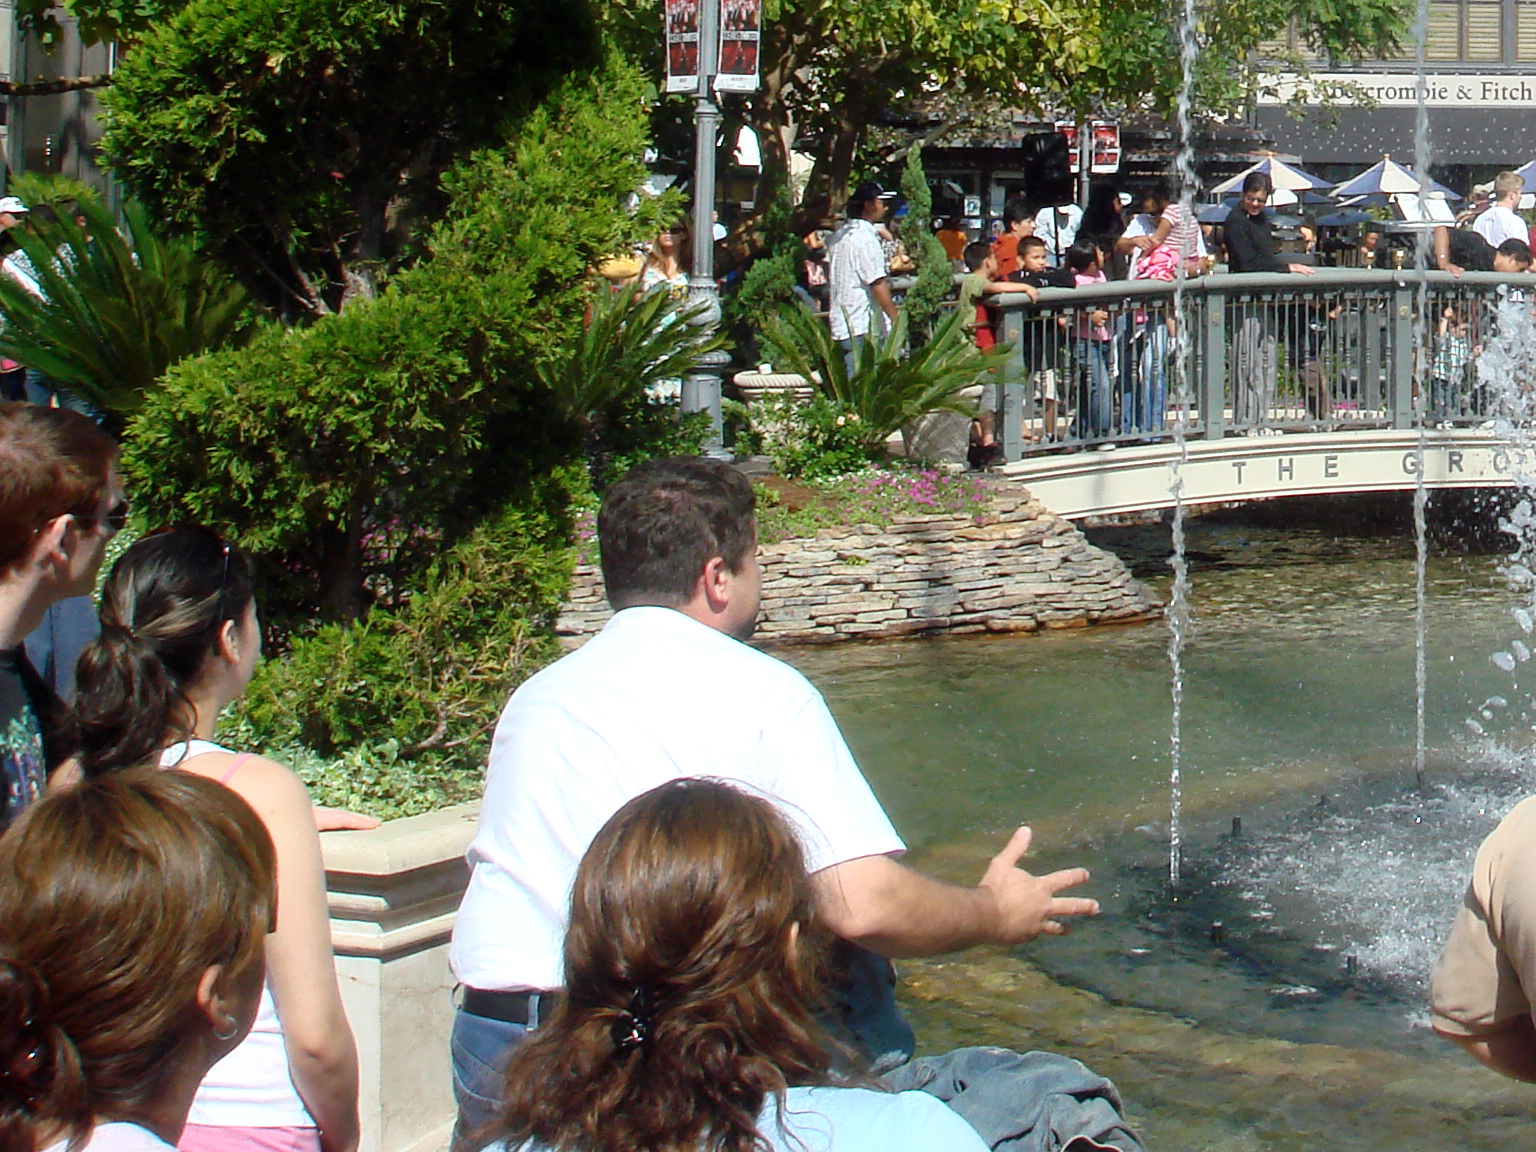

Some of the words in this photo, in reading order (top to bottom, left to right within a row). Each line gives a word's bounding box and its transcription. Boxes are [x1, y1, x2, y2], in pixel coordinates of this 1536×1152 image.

[1456, 84, 1473, 101] &
[1480, 81, 1533, 101] Fitch
[1231, 455, 1339, 485] THE
